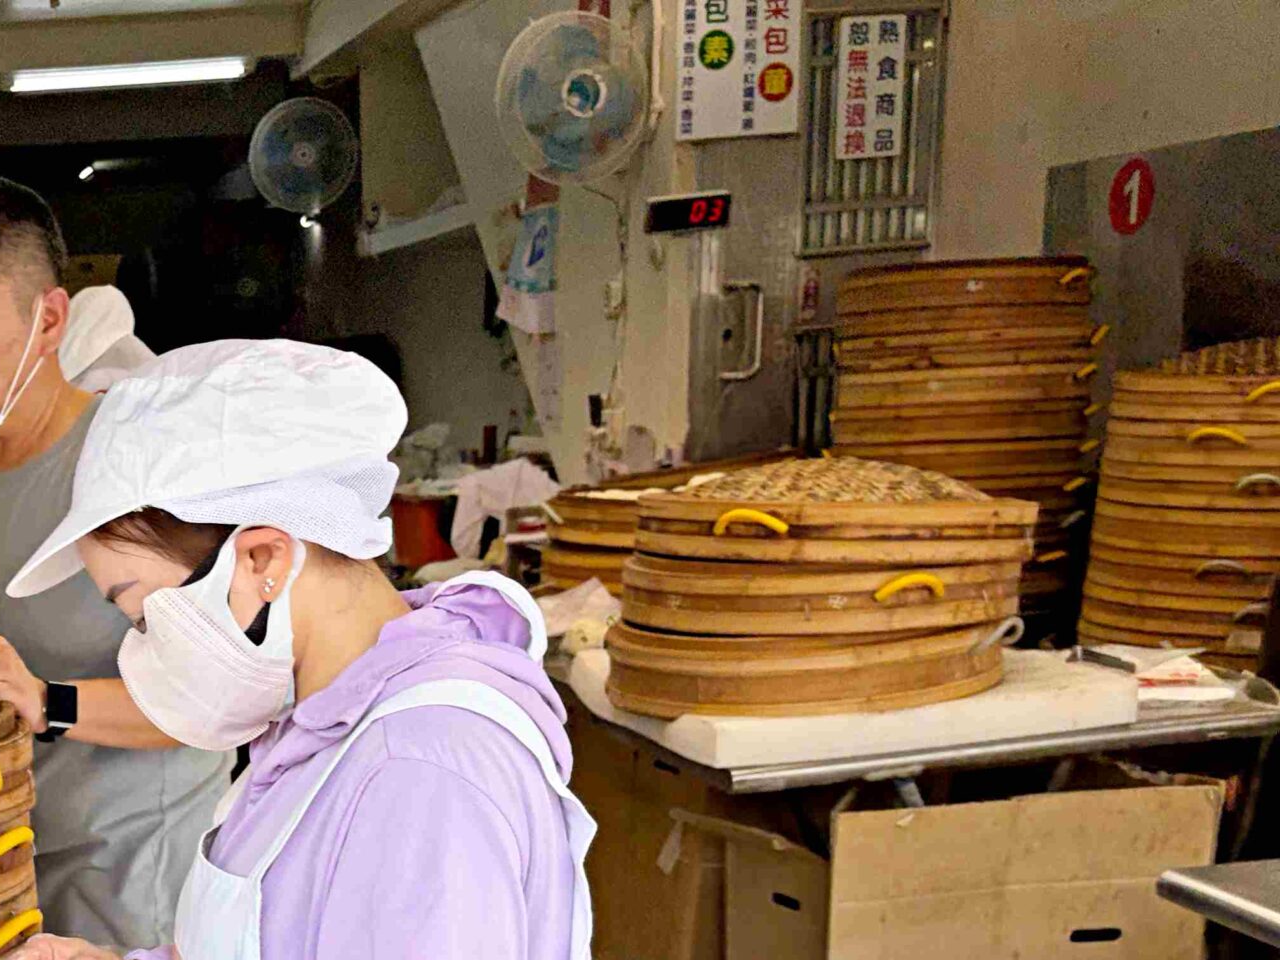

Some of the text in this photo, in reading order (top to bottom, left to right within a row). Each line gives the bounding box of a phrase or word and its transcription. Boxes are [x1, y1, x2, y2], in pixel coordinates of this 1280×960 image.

[844, 22, 869, 154] 恕無法退換
[873, 20, 899, 152] 熱食商品
[688, 197, 725, 224] 03
[1123, 168, 1141, 225] 1
